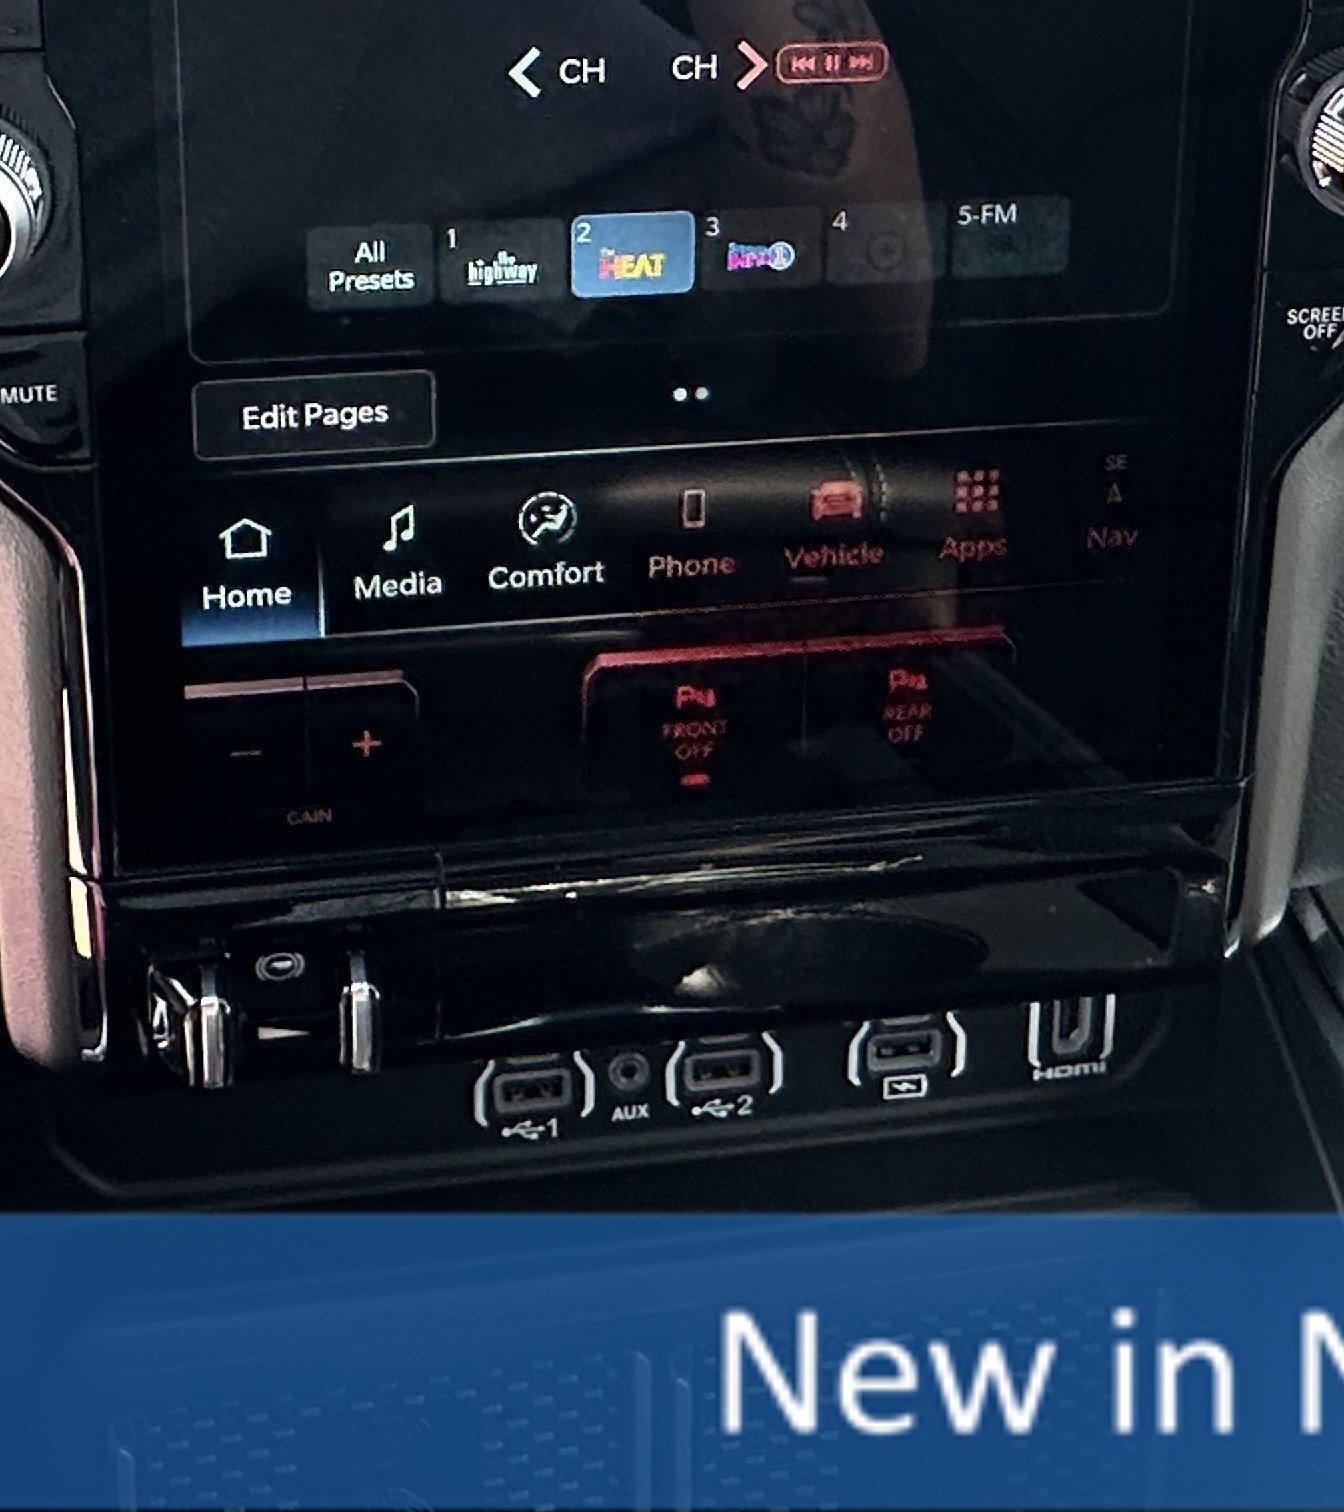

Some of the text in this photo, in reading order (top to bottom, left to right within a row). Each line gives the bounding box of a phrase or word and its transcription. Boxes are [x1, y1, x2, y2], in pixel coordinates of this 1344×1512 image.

[558, 57, 606, 85] CH
[671, 54, 719, 82] CH
[831, 211, 848, 232] 4
[956, 202, 1019, 226] 5-FM
[576, 223, 592, 243] 2
[704, 215, 721, 237] 3
[446, 228, 457, 249] 1
[355, 241, 386, 264] All
[467, 259, 538, 285] highway
[599, 252, 666, 280] HEAT
[329, 268, 416, 292] Presets
[1302, 323, 1338, 340] OFF
[0, 384, 58, 405] MUTE
[242, 402, 390, 431] Edit Pages
[938, 534, 1009, 564] Apps
[1086, 526, 1139, 550] Nav
[648, 554, 736, 579] Phone
[783, 541, 885, 570] Vehicle
[354, 571, 442, 601] Media
[487, 560, 605, 590] Comfort
[201, 584, 292, 610] Home
[882, 702, 933, 722] REAR
[662, 717, 729, 740] FRONT
[887, 723, 925, 744] OFF
[674, 740, 716, 762] OFF
[286, 808, 333, 826] GAIN
[610, 1102, 651, 1123] AUX
[737, 1095, 754, 1117] 2
[547, 1117, 558, 1138] 1
